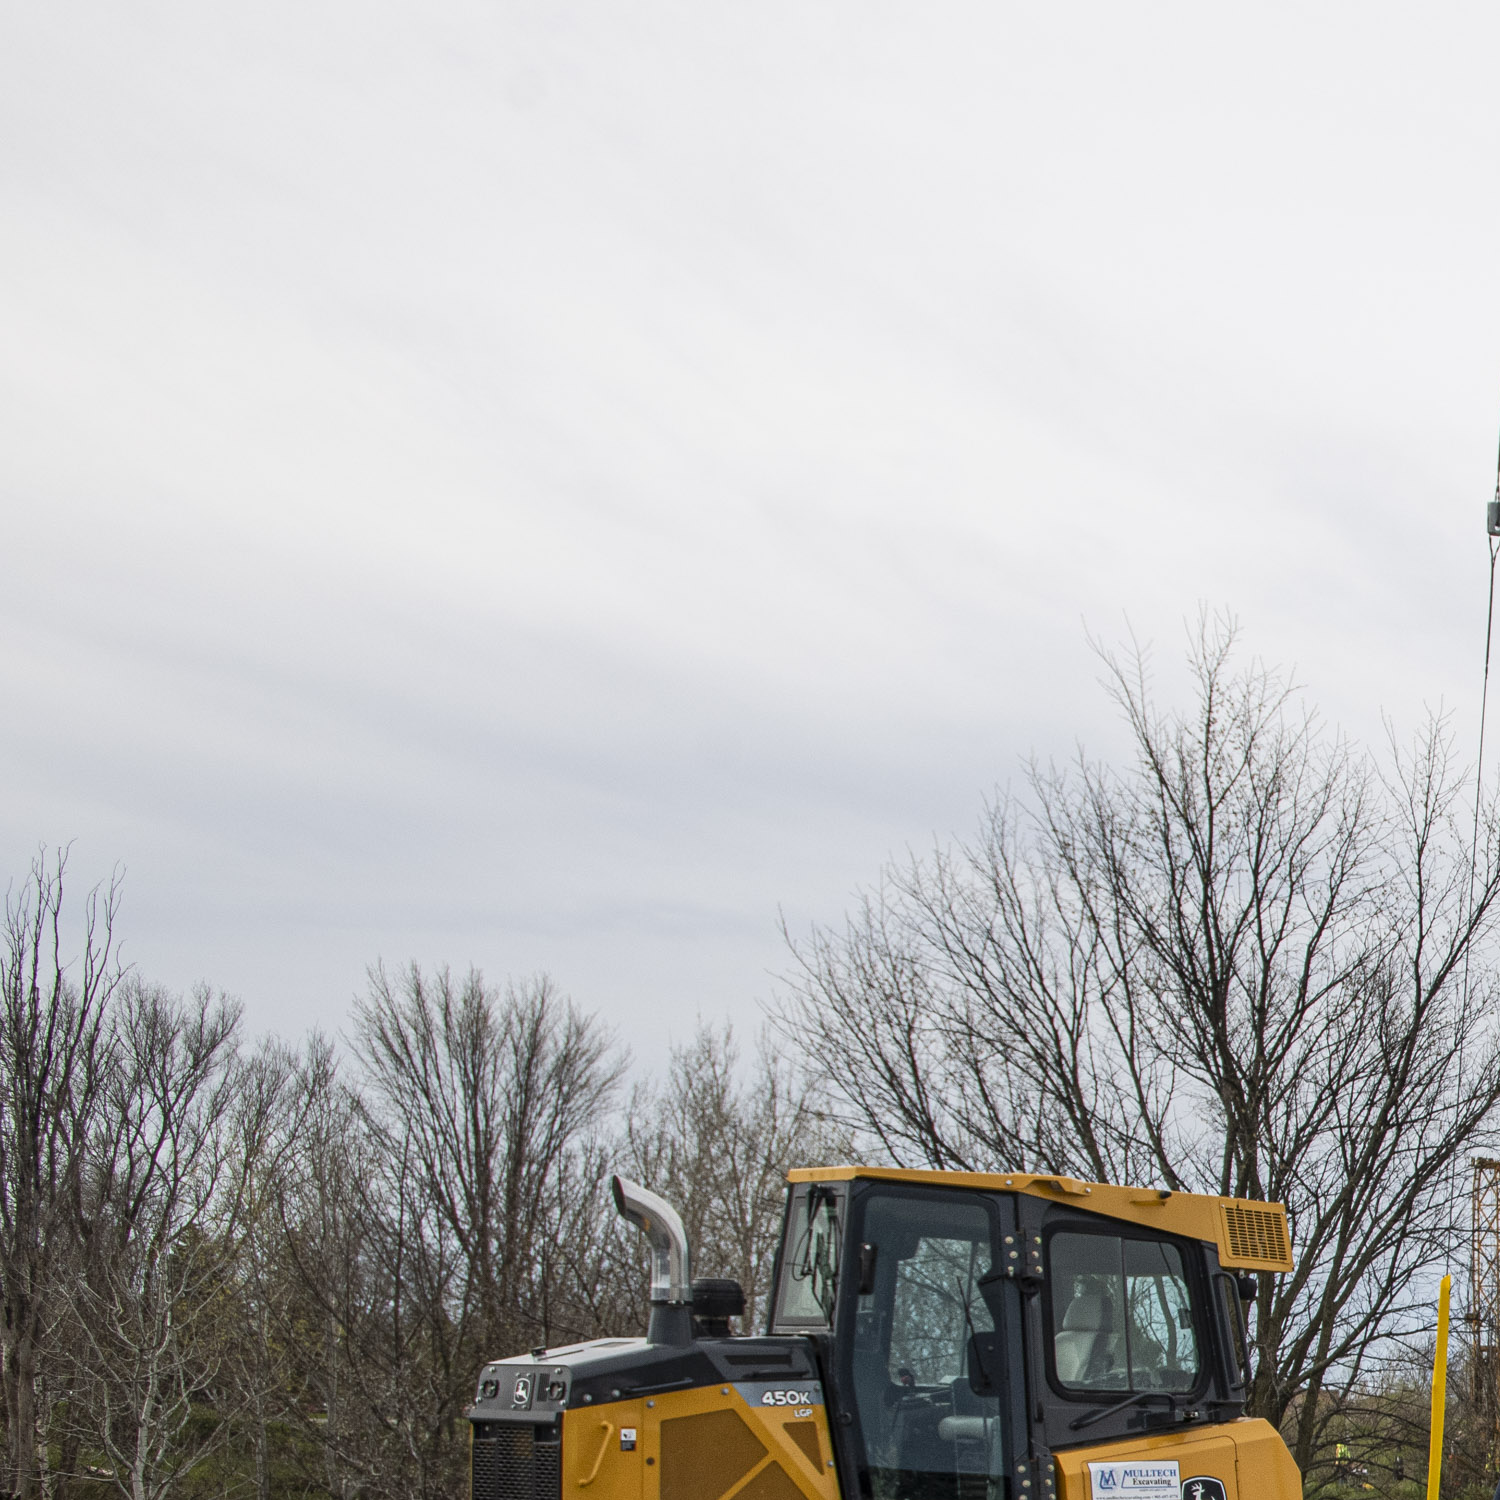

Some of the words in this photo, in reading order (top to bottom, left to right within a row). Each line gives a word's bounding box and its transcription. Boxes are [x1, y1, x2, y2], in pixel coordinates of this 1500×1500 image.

[762, 1390, 811, 1405] 450K
[794, 1409, 813, 1417] LGP
[1123, 1469, 1176, 1477] MULLTECH
[1133, 1478, 1171, 1486] Excavating
